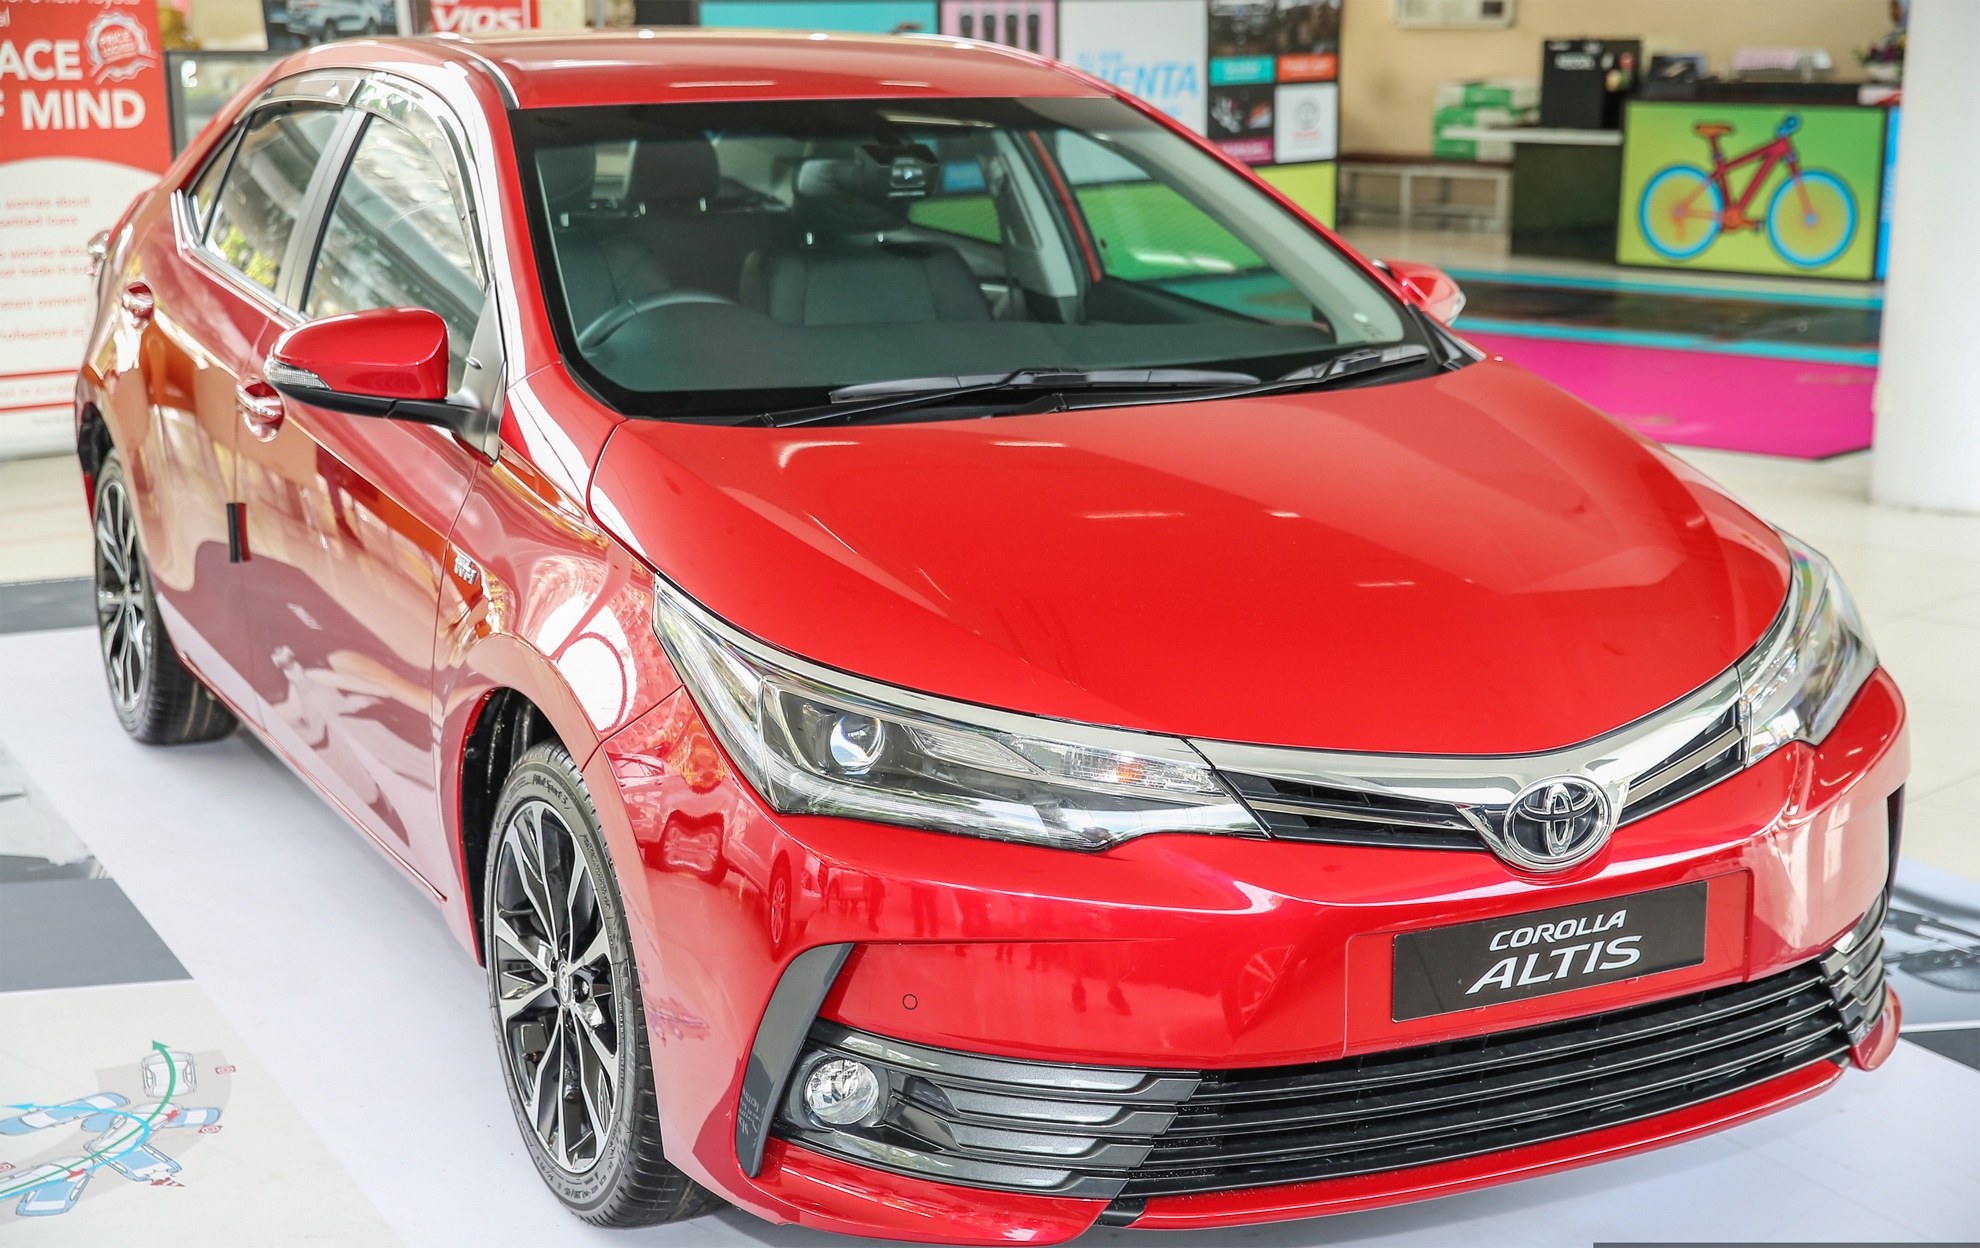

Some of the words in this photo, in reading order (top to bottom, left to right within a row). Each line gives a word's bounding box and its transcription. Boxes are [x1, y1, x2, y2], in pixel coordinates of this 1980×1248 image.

[431, 6, 523, 33] VIOS
[20, 88, 147, 131] MIND
[1489, 909, 1627, 952] COROLLA
[1465, 935, 1643, 995] ALTIS
